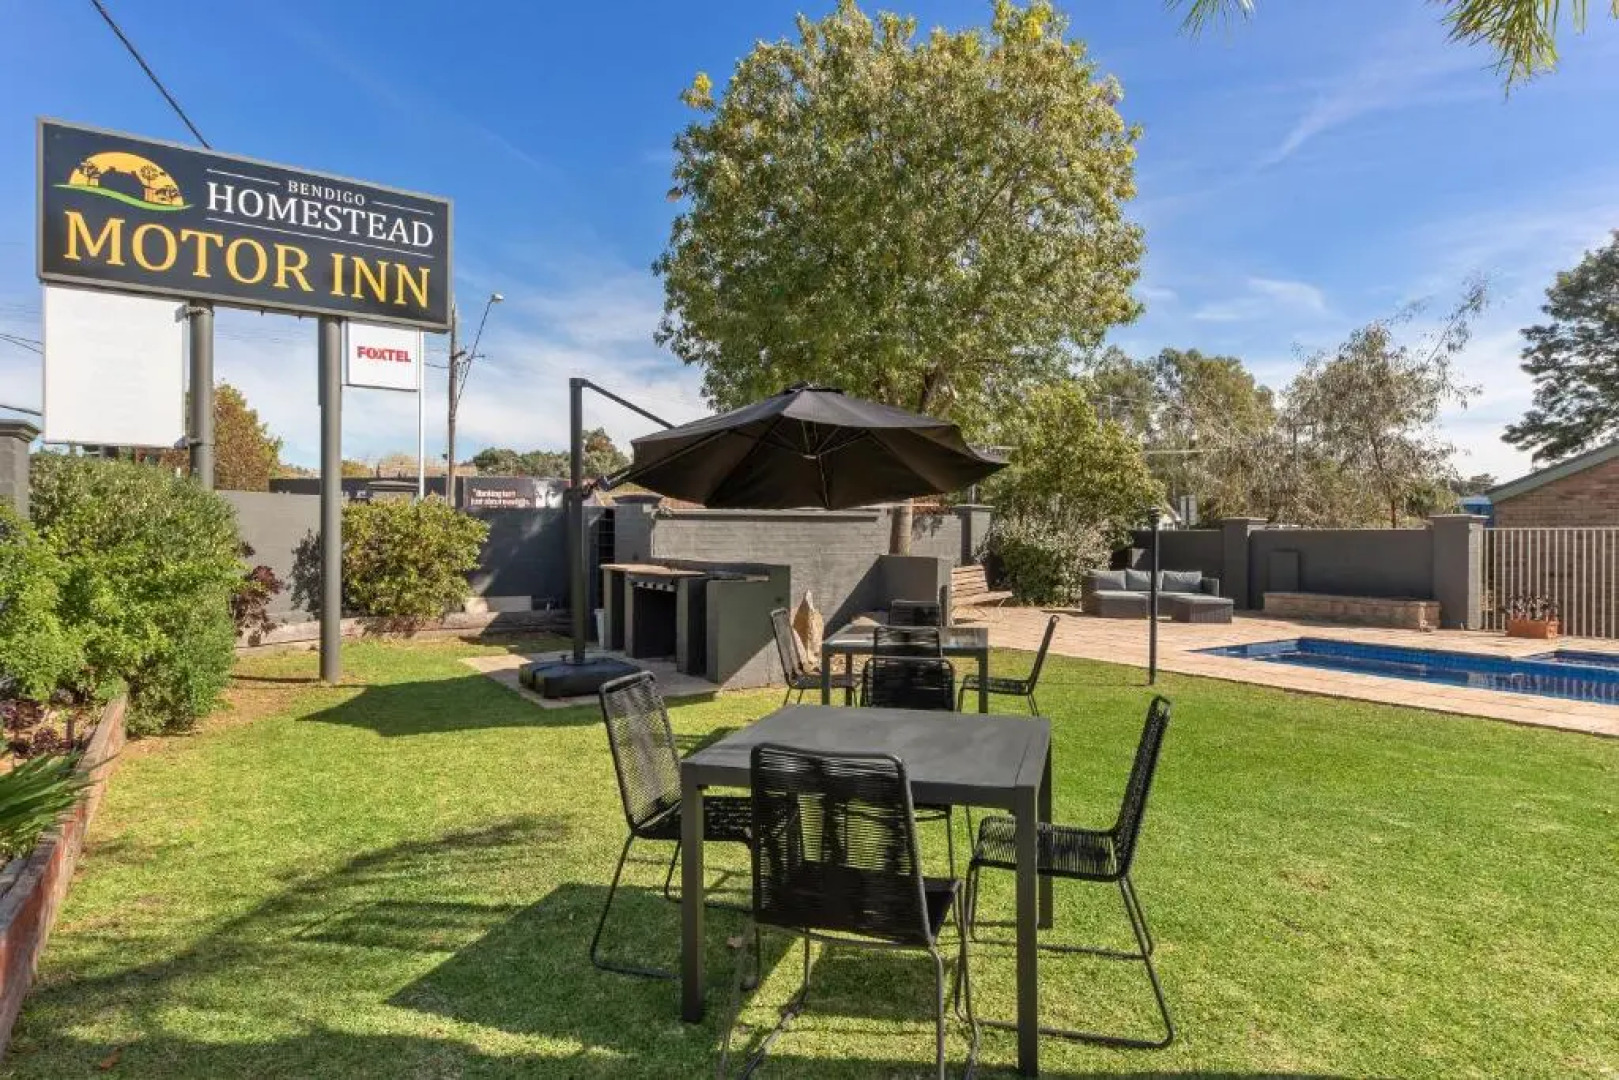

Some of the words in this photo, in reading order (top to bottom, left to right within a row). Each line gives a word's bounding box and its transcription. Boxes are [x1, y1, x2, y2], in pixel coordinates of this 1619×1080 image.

[206, 181, 434, 248] HOMESTEAD
[287, 179, 366, 206] BENDIGO
[63, 209, 314, 292] MOTOR
[329, 252, 431, 309] INN
[356, 345, 412, 363] FOXTEL
